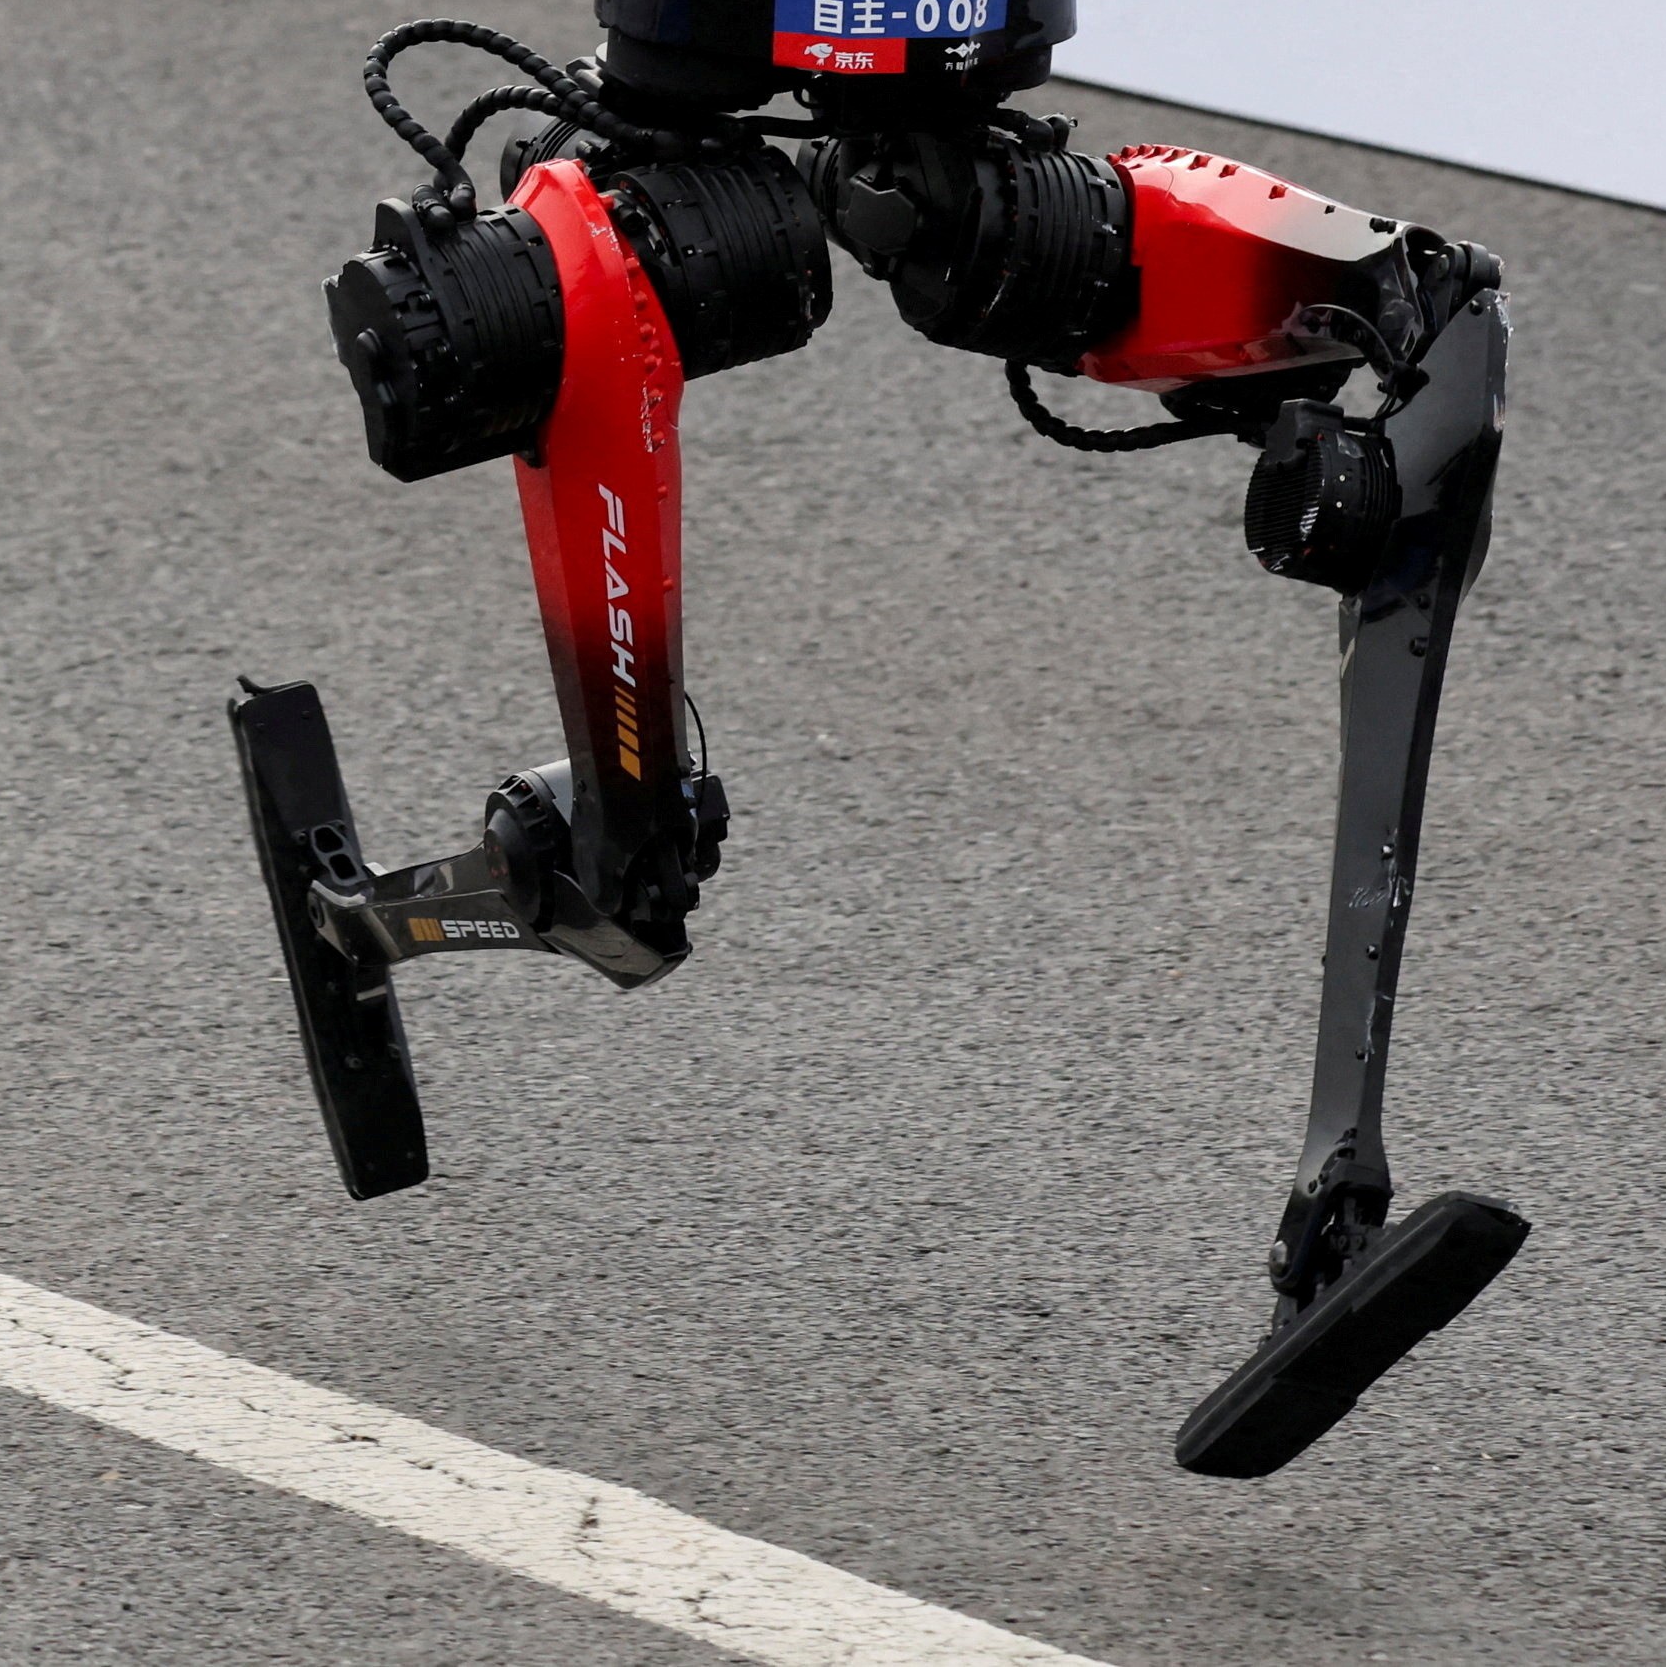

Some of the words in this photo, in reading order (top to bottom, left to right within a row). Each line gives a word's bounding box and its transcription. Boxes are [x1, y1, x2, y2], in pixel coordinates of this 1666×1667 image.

[834, 51, 874, 70] 京东
[599, 483, 636, 688] FLASH
[440, 919, 520, 939] SPEED
